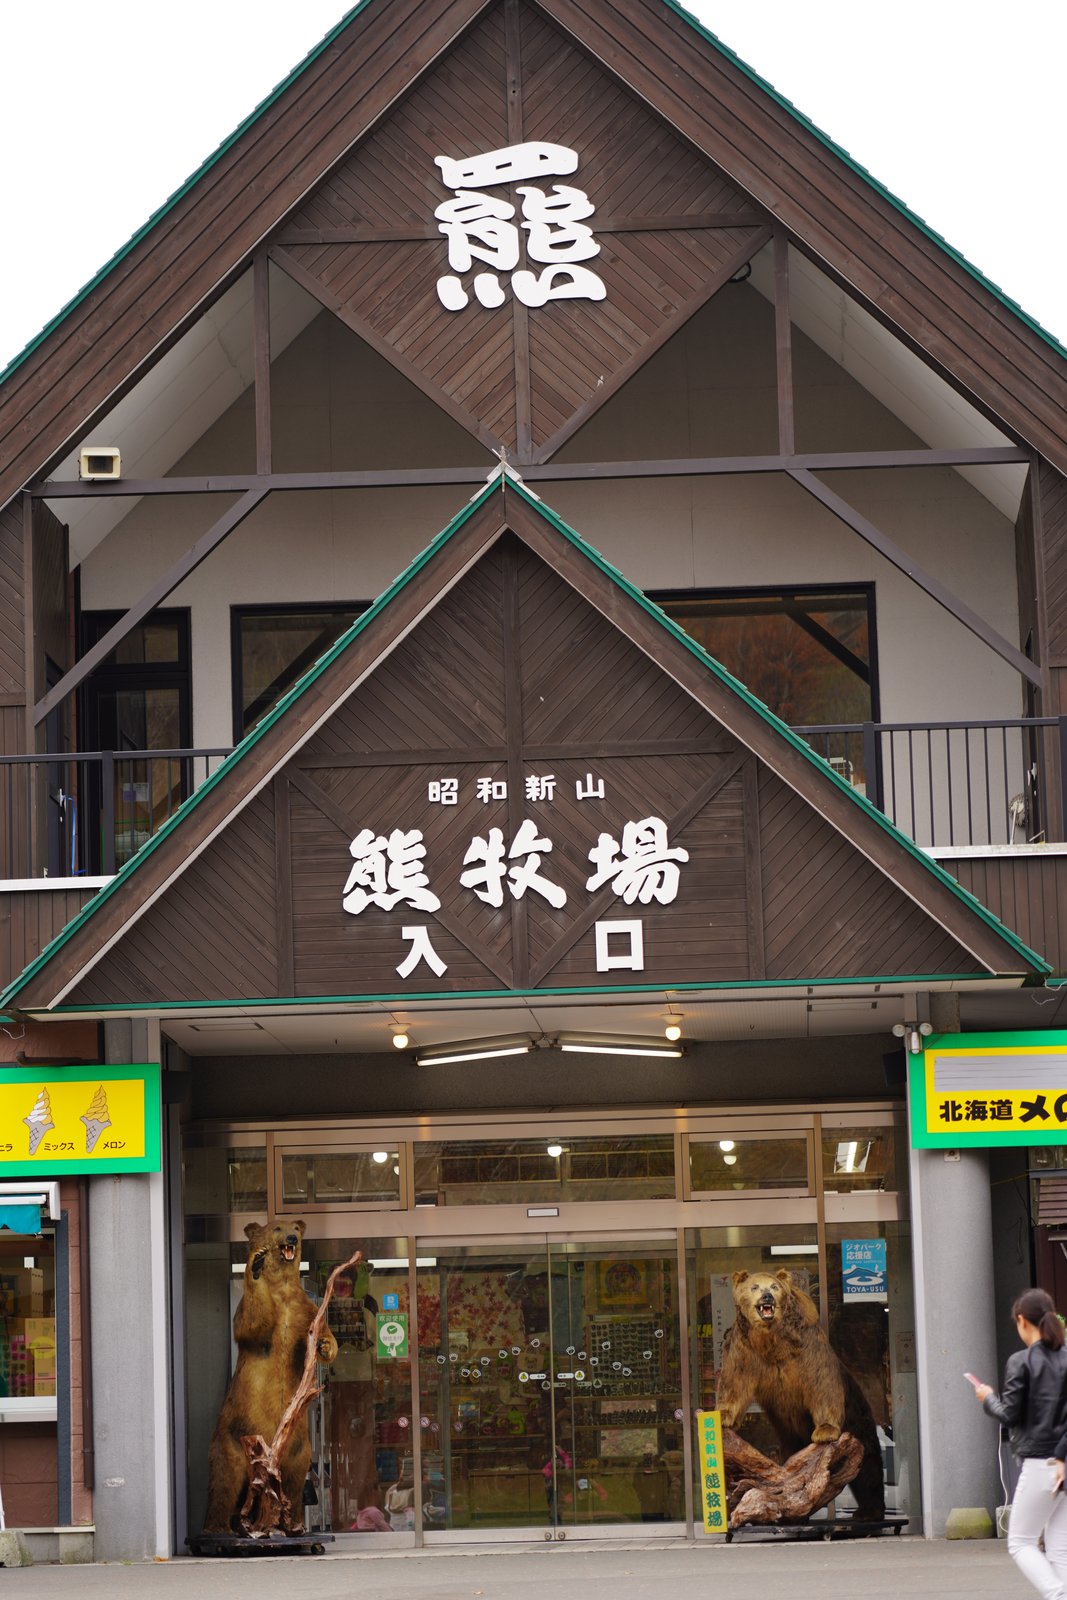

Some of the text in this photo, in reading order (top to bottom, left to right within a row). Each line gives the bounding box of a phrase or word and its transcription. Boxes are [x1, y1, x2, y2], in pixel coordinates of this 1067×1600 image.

[428, 773, 606, 806] 昭和新山
[342, 815, 690, 916] 熊牧場
[395, 919, 645, 979] 入口
[43, 1142, 75, 1151] ミックス
[103, 1141, 126, 1149] メロン
[846, 1243, 882, 1251] ジオパーク
[846, 1251, 872, 1260] 応援店
